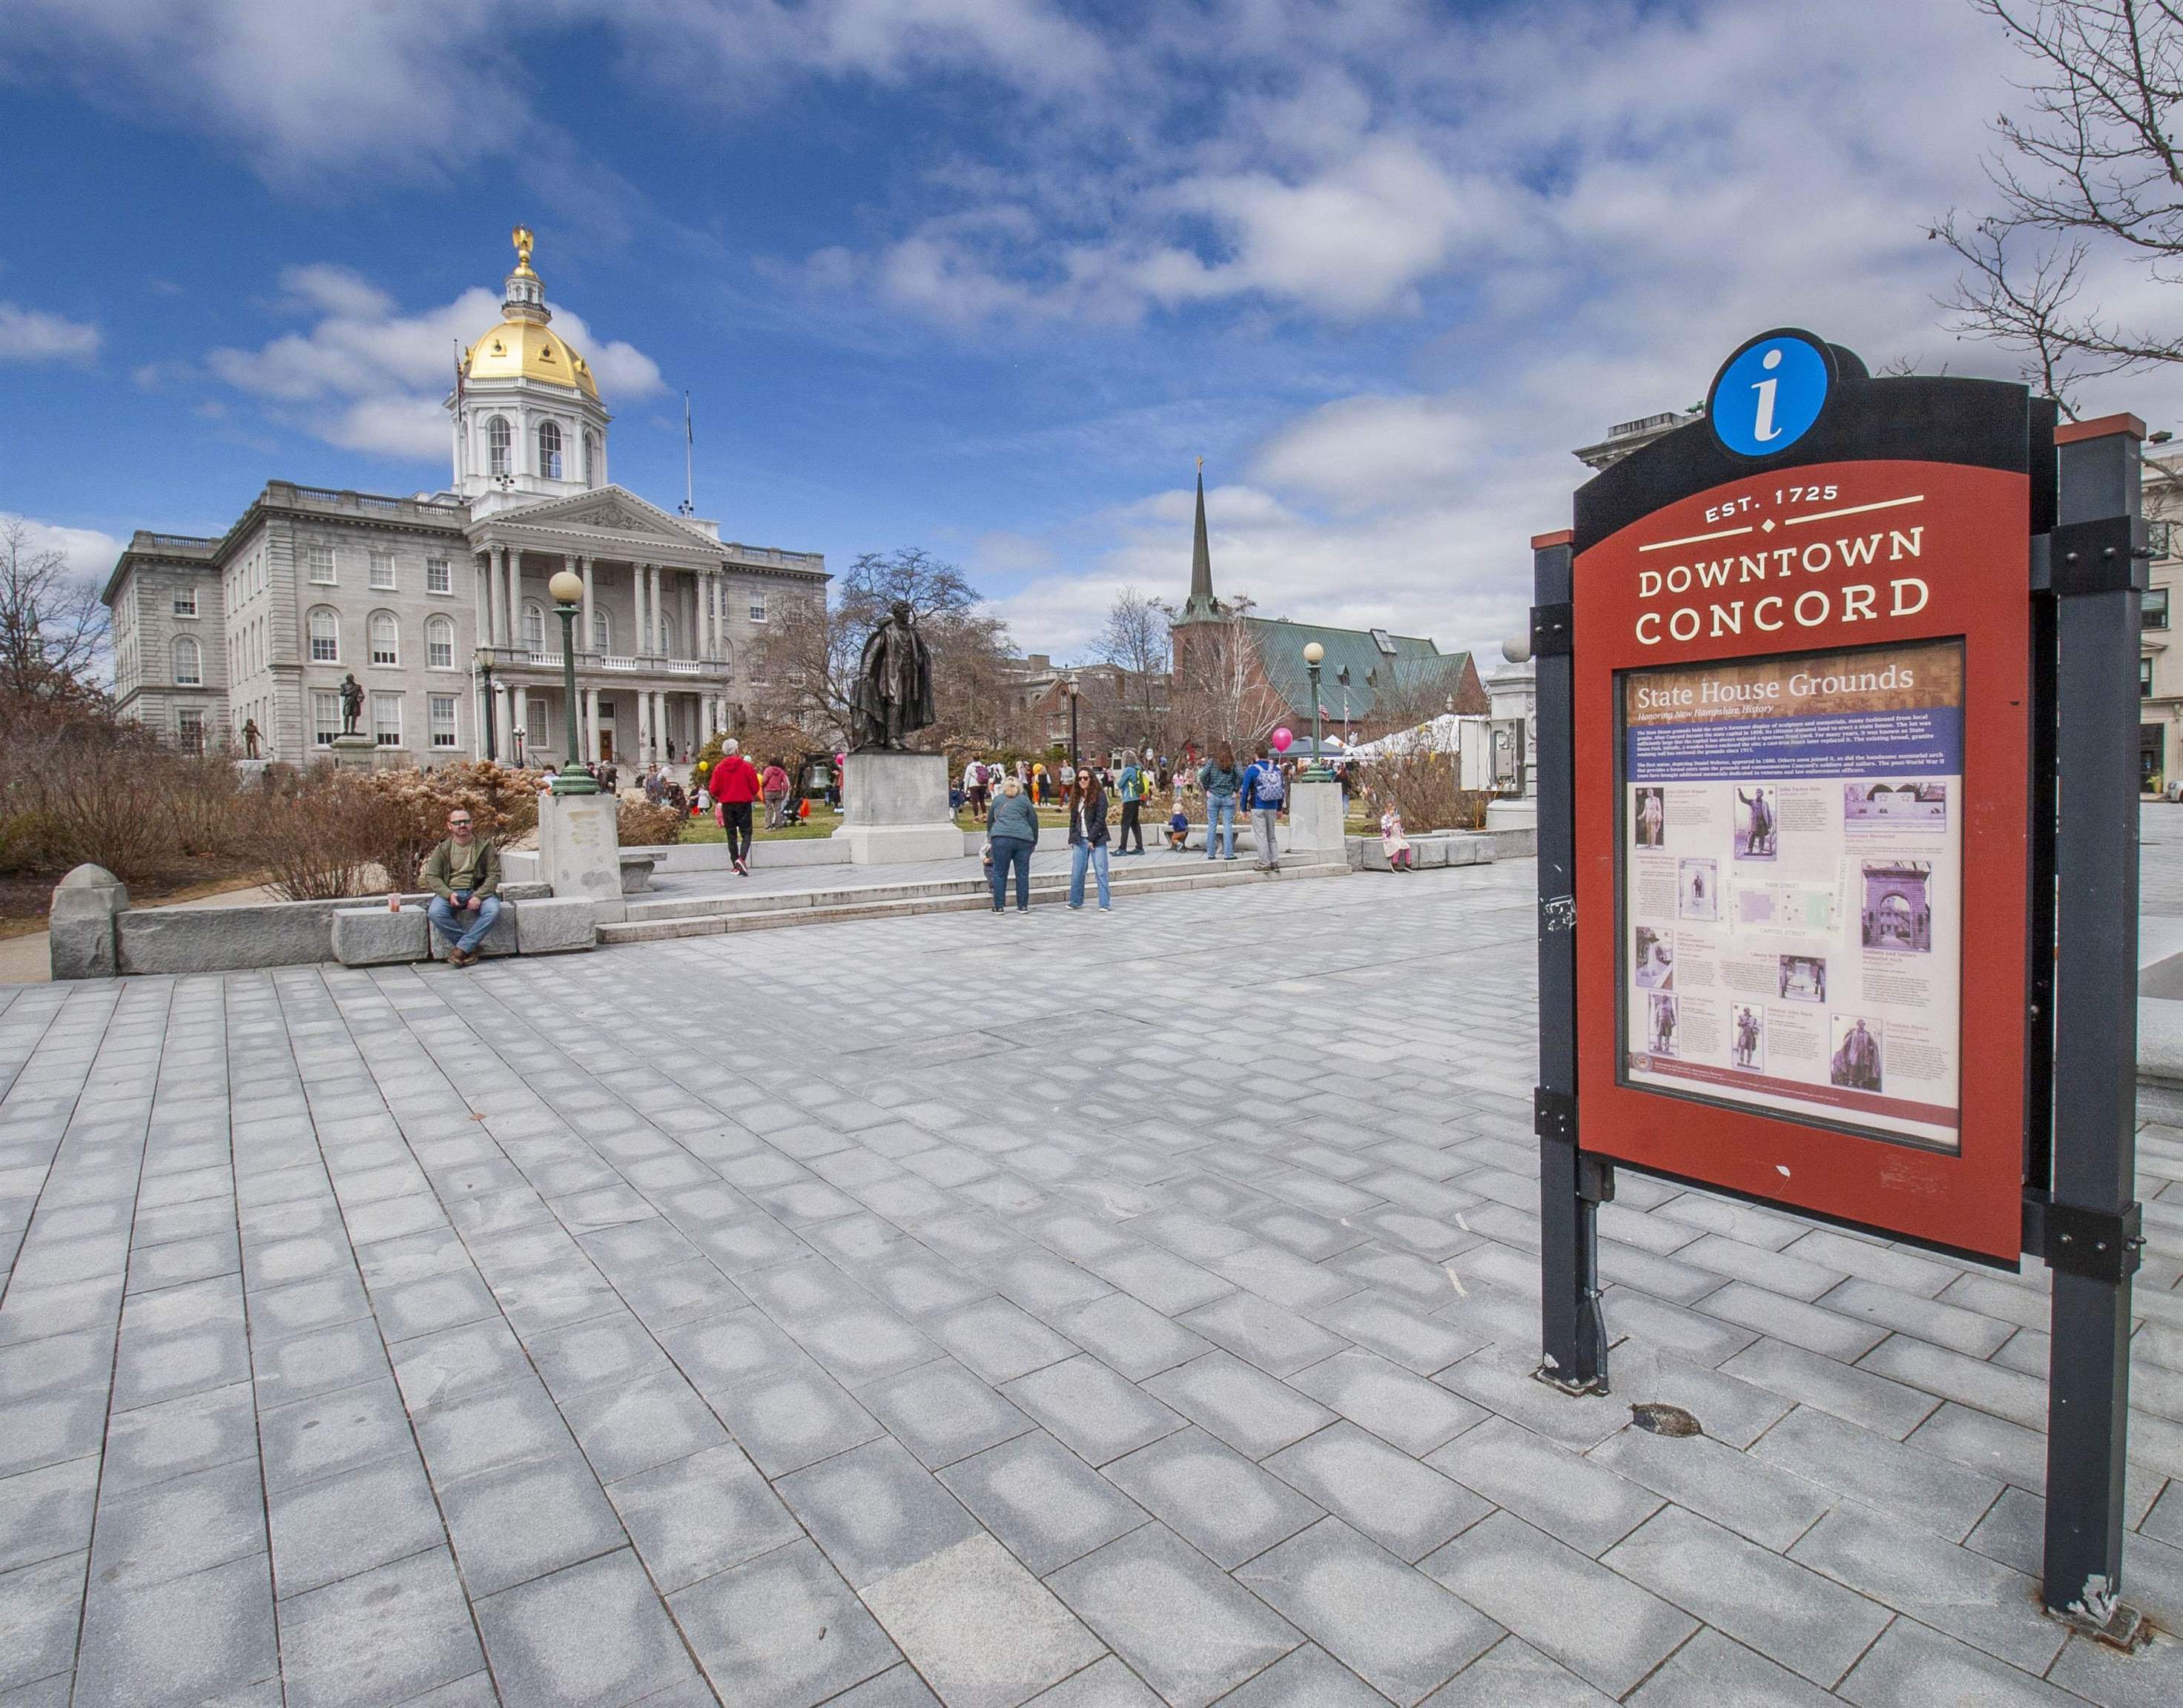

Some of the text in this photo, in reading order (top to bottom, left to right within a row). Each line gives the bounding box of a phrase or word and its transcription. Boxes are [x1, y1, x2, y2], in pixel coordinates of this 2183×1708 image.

[1705, 485, 1839, 523] EST. 1725
[1639, 527, 1924, 598] DOWNTOWN
[1635, 578, 1929, 645] CONCORD
[1638, 665, 1915, 709] State House Grounds
[1637, 705, 1774, 721] Honoring New Hampshire History
